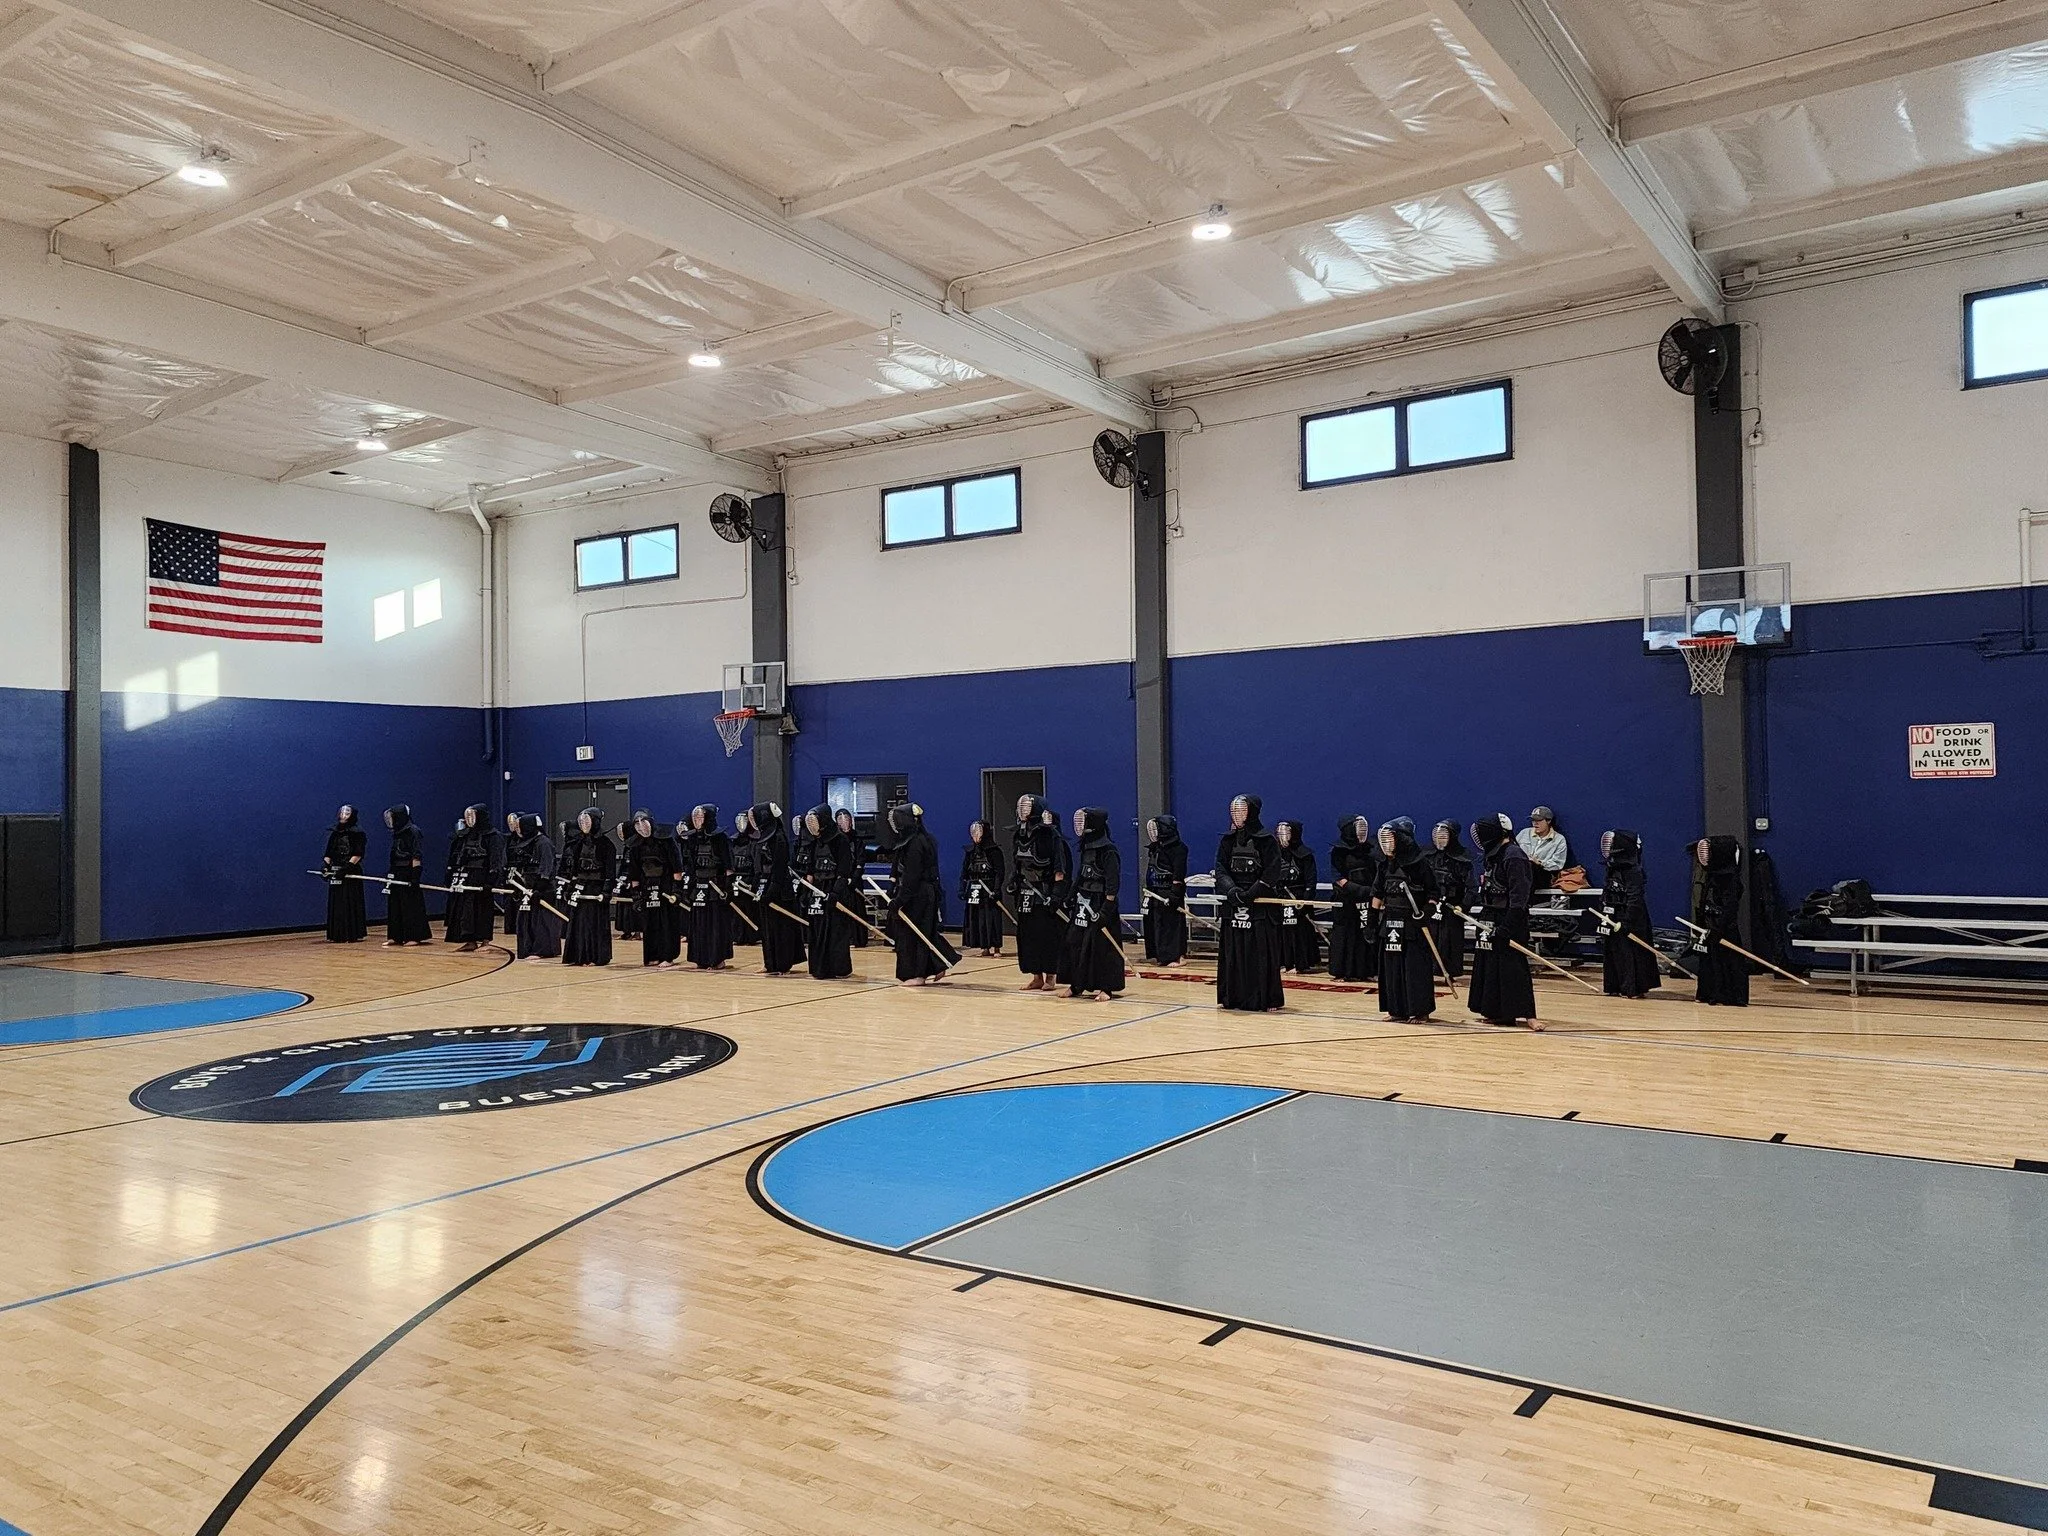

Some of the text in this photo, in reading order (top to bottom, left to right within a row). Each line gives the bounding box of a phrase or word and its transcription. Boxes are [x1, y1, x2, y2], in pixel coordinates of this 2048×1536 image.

[1912, 727, 1934, 744] NO
[1936, 728, 1971, 736] FOOD
[1944, 738, 1982, 747] DRINK
[1922, 749, 1982, 758] ALLOWED
[1915, 758, 1990, 768] IN THE GYM
[169, 1026, 549, 1091] BOYS & GIRLS CLUB
[437, 1054, 706, 1111] BUENA PARK
